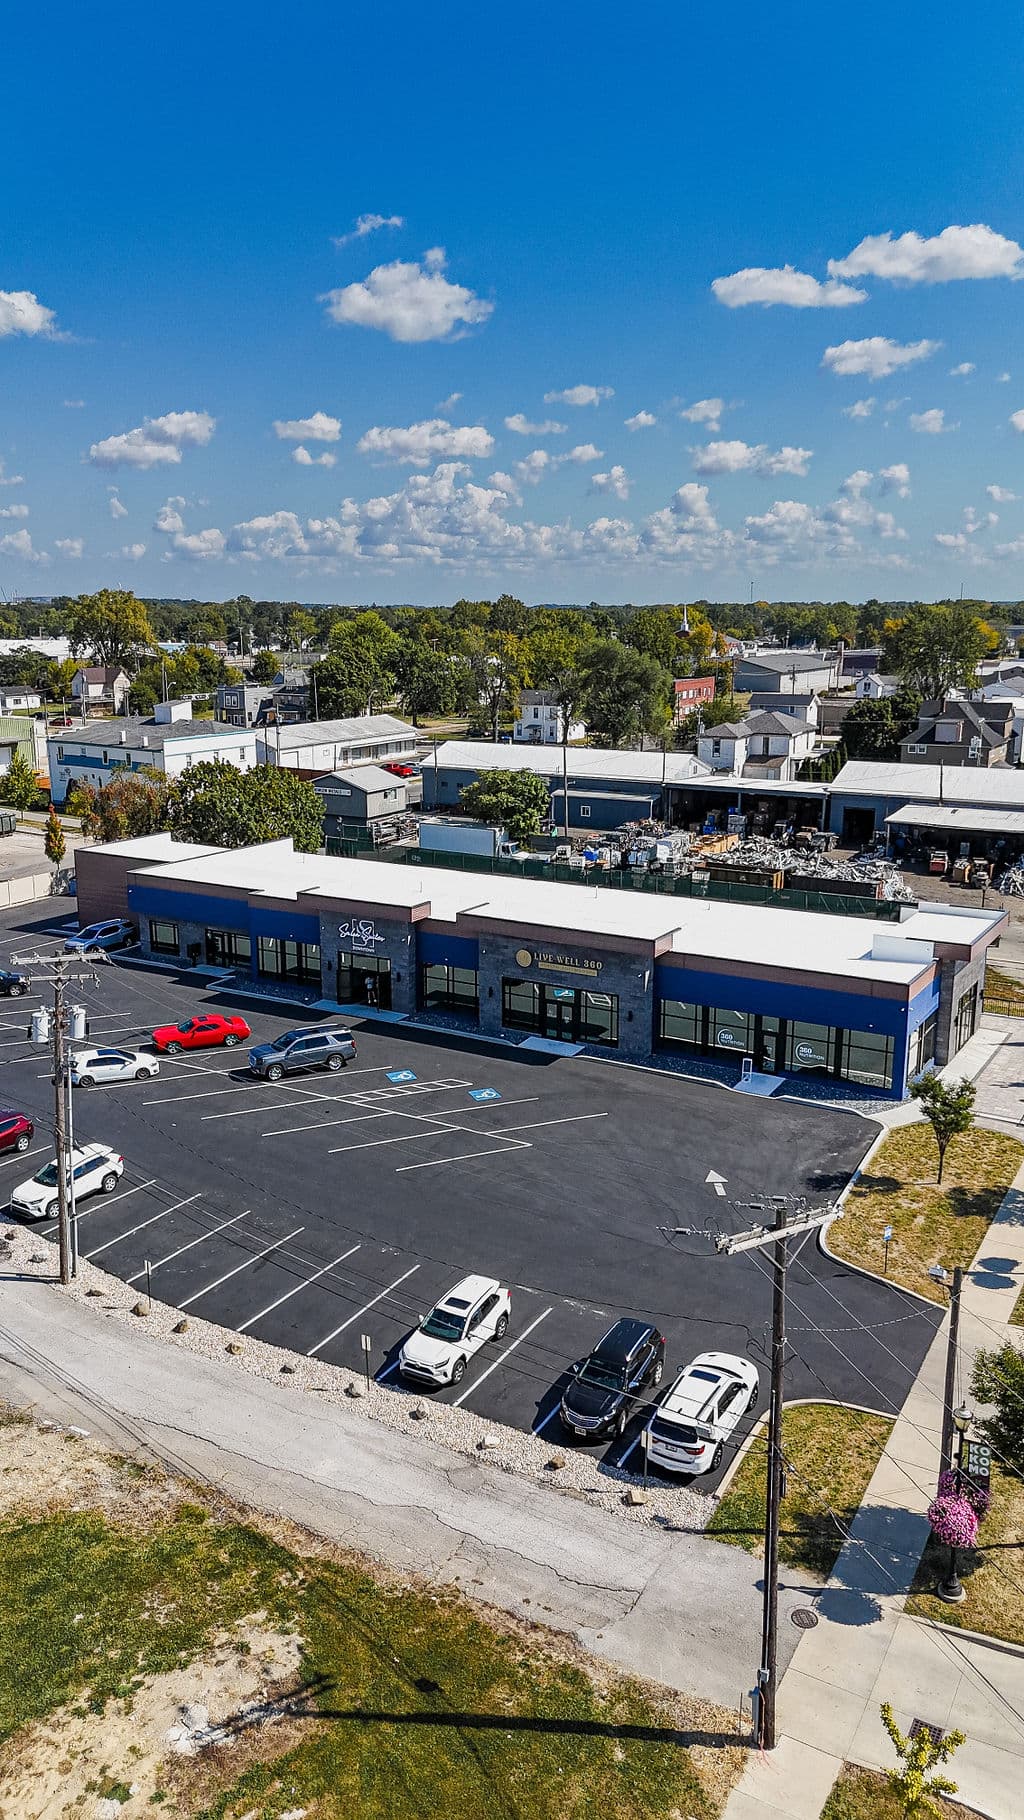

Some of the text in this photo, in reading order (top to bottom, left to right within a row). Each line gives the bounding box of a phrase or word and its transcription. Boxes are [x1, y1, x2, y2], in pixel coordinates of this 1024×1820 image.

[534, 952, 554, 963] LIVE
[557, 956, 580, 966] WELL
[583, 959, 603, 970] 360
[720, 1032, 733, 1041] 360
[799, 1046, 813, 1054] 360
[969, 1443, 991, 1456] KO
[969, 1453, 990, 1466] KO
[968, 1463, 990, 1477] MO
